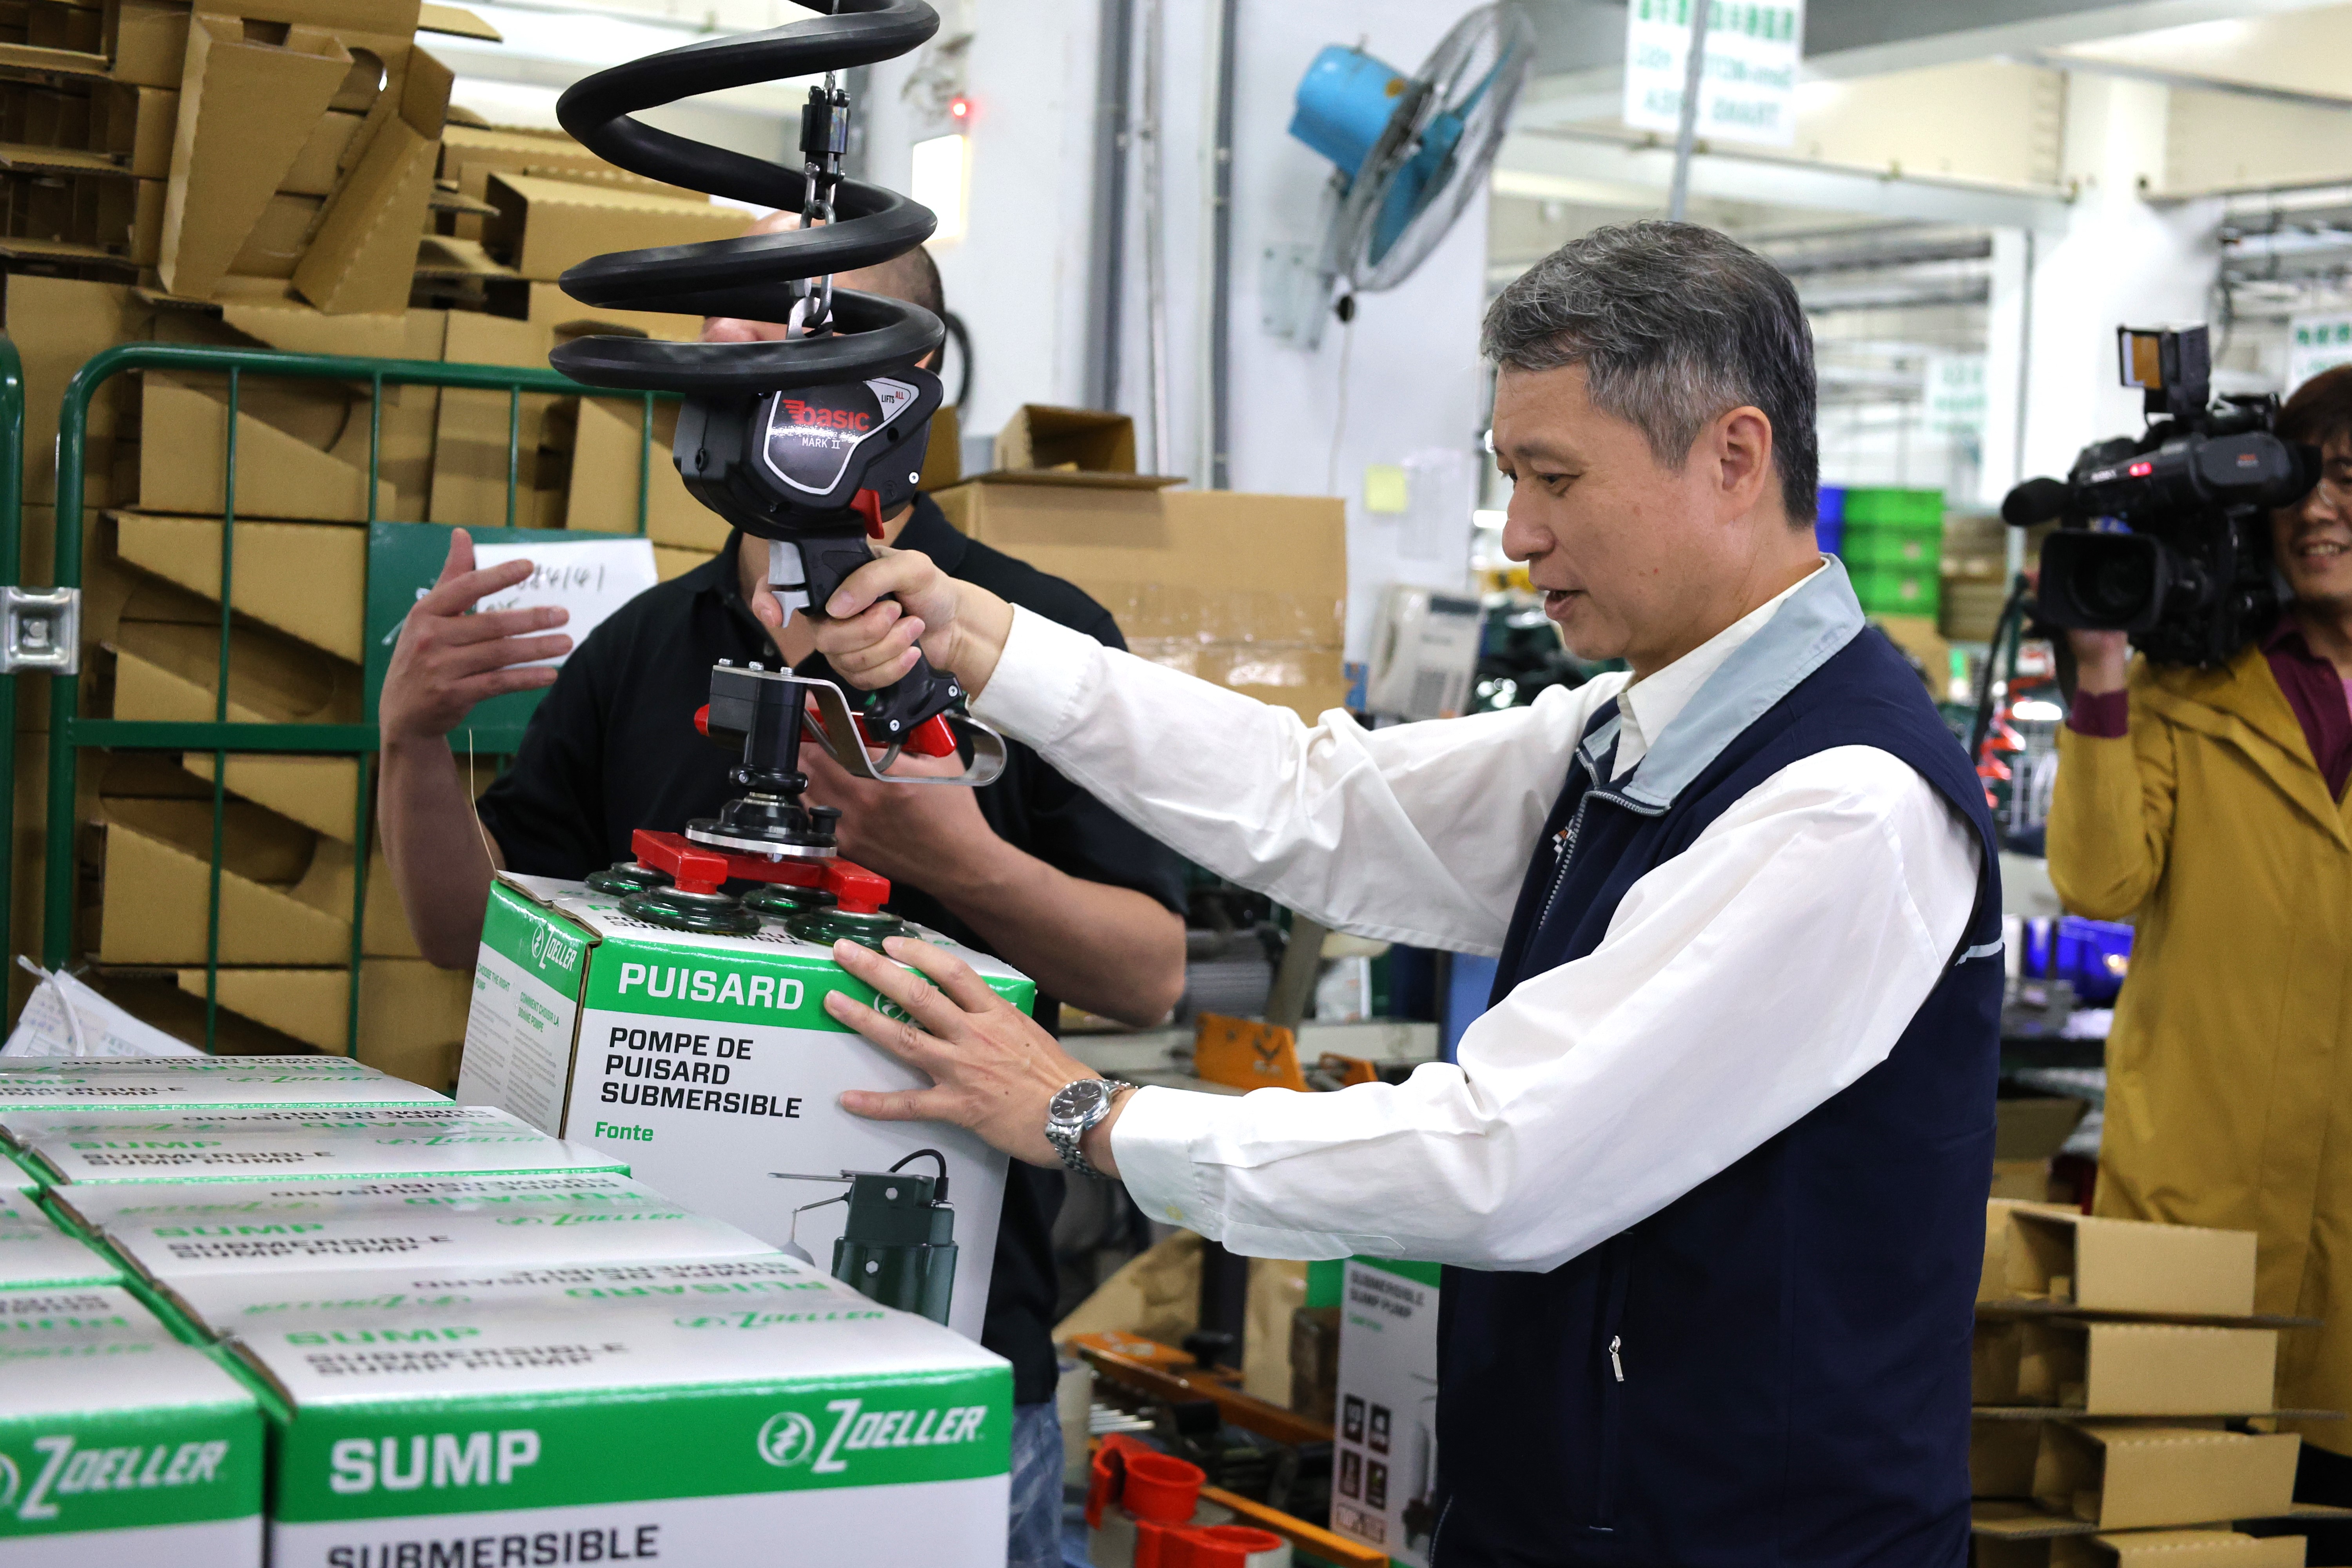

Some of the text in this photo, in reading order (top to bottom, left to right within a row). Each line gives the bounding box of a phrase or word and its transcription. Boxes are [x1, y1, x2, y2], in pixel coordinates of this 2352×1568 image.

[881, 391, 904, 403] LIFTS ALL
[786, 399, 870, 431] basic
[802, 437, 840, 449] MARK II
[610, 921, 809, 946] SUBIBLE
[539, 926, 578, 971] ZOELLER
[618, 962, 804, 1010] PUISARD
[609, 1027, 753, 1060] POMPE DE
[605, 1054, 730, 1085] PUISARD
[601, 1082, 802, 1118] SUBMERSIBLE
[595, 1121, 653, 1142] Fonte
[70, 1141, 221, 1149] SUMP
[404, 1192, 642, 1205] PUISARD
[152, 1223, 324, 1238] SUMP
[169, 1235, 454, 1250] SUBMERSIBLE
[175, 1244, 419, 1259] SUMP PUMP
[565, 1280, 829, 1299] PUISARD
[285, 1326, 481, 1347] SUMP
[305, 1342, 629, 1364] SUBMERSIBLE
[315, 1352, 593, 1376] SUMP PUMP
[810, 1397, 988, 1474] ZOELLER
[330, 1428, 541, 1494] SUMP
[16, 1434, 229, 1520] ZOELLER
[326, 1523, 659, 1568] SUBMERSIBLE
